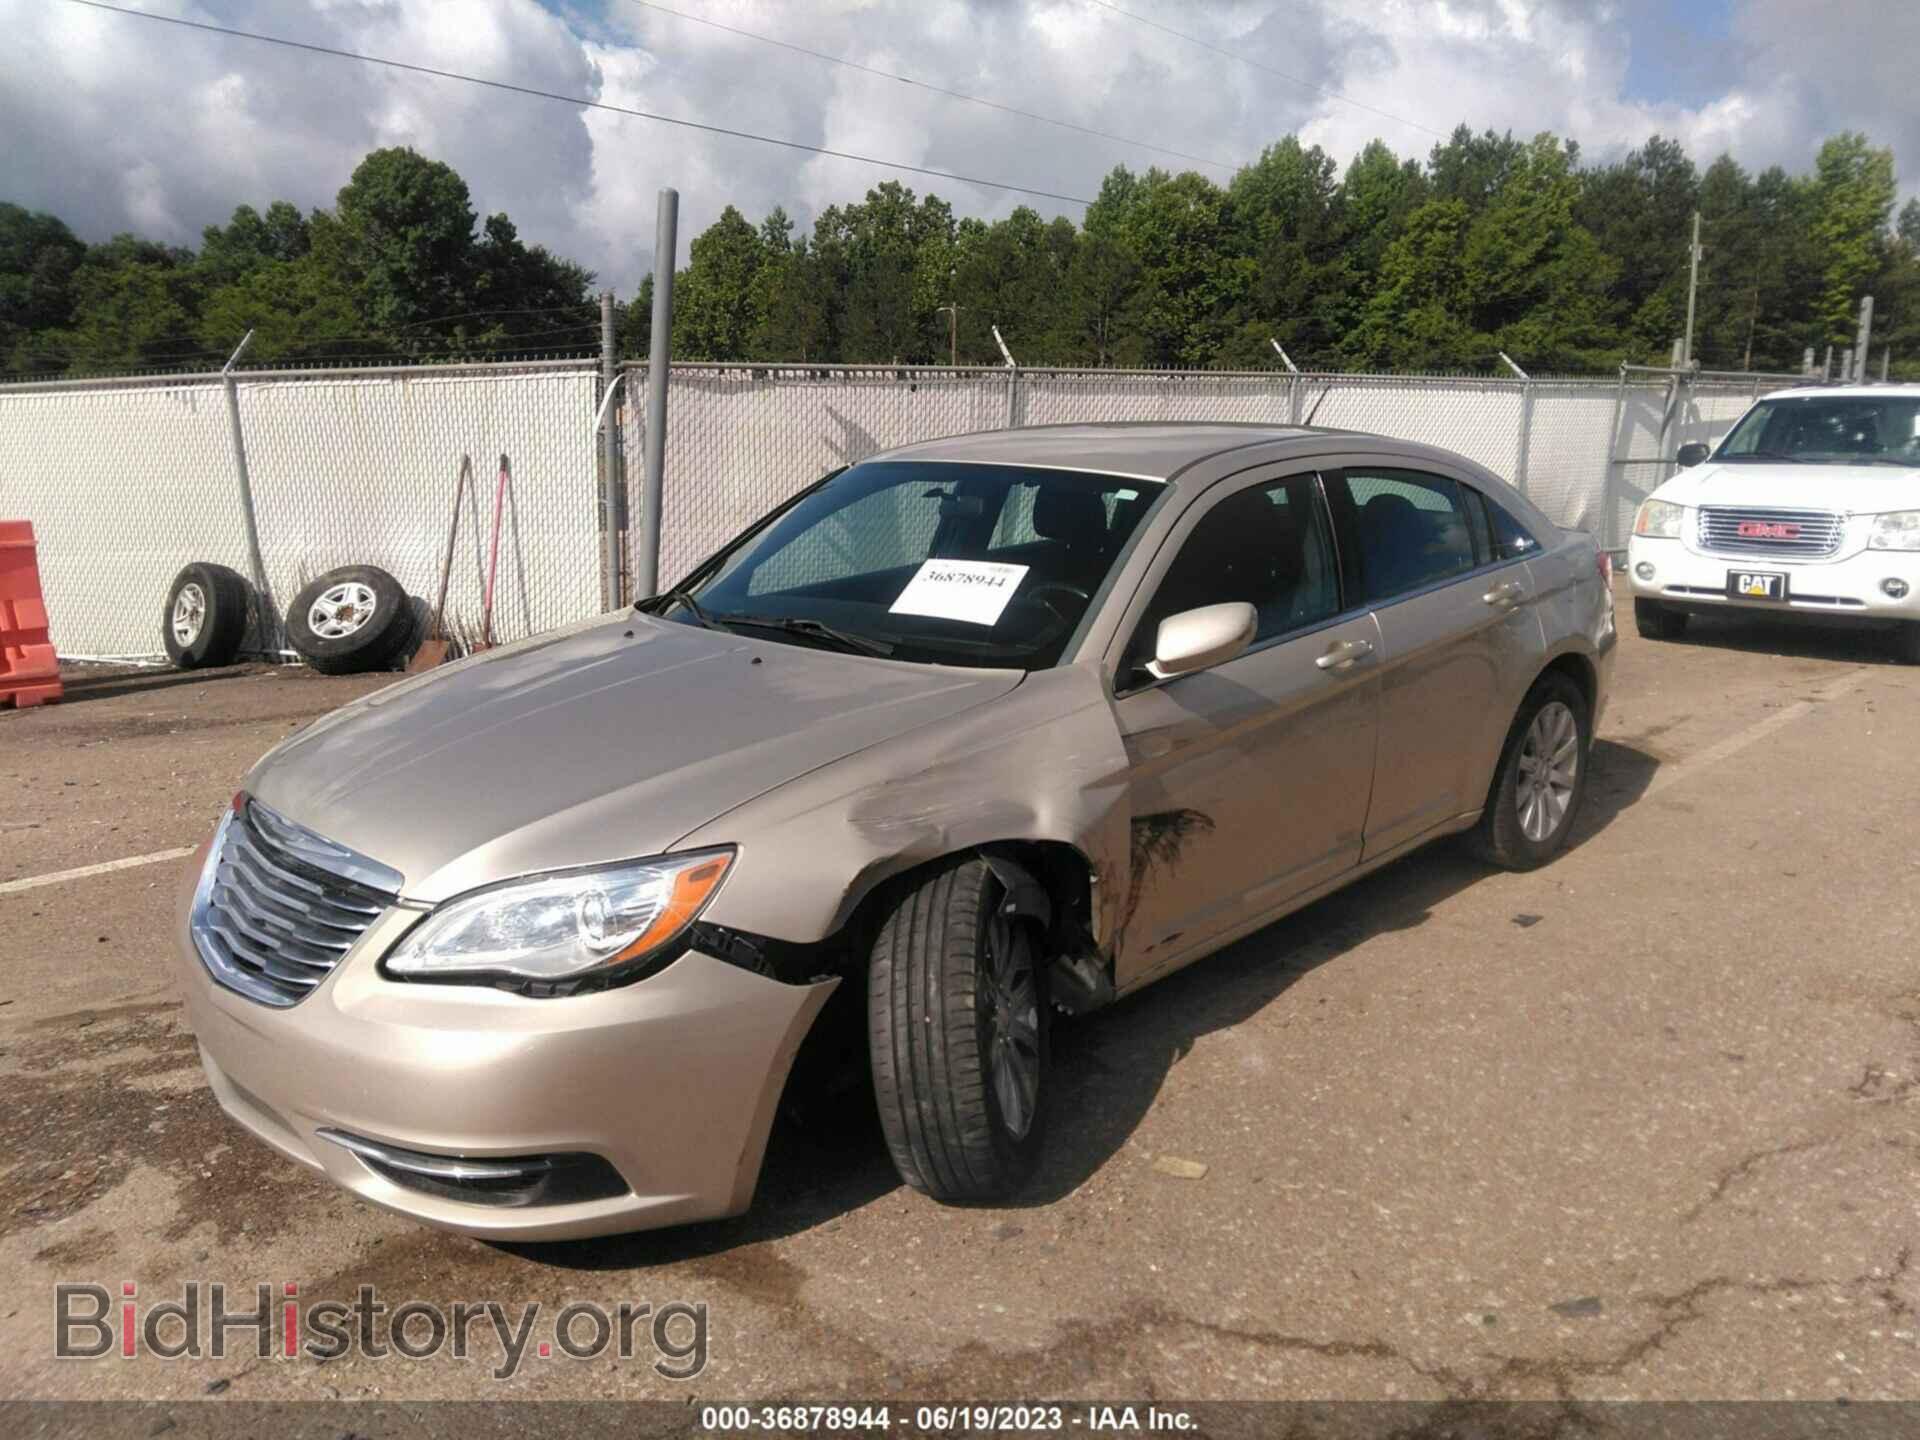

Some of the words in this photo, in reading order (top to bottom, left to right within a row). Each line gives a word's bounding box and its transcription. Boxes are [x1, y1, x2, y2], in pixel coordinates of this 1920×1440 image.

[1737, 521, 1801, 540] GMC
[922, 570, 1007, 588] 36878944
[1738, 574, 1776, 596] CAT
